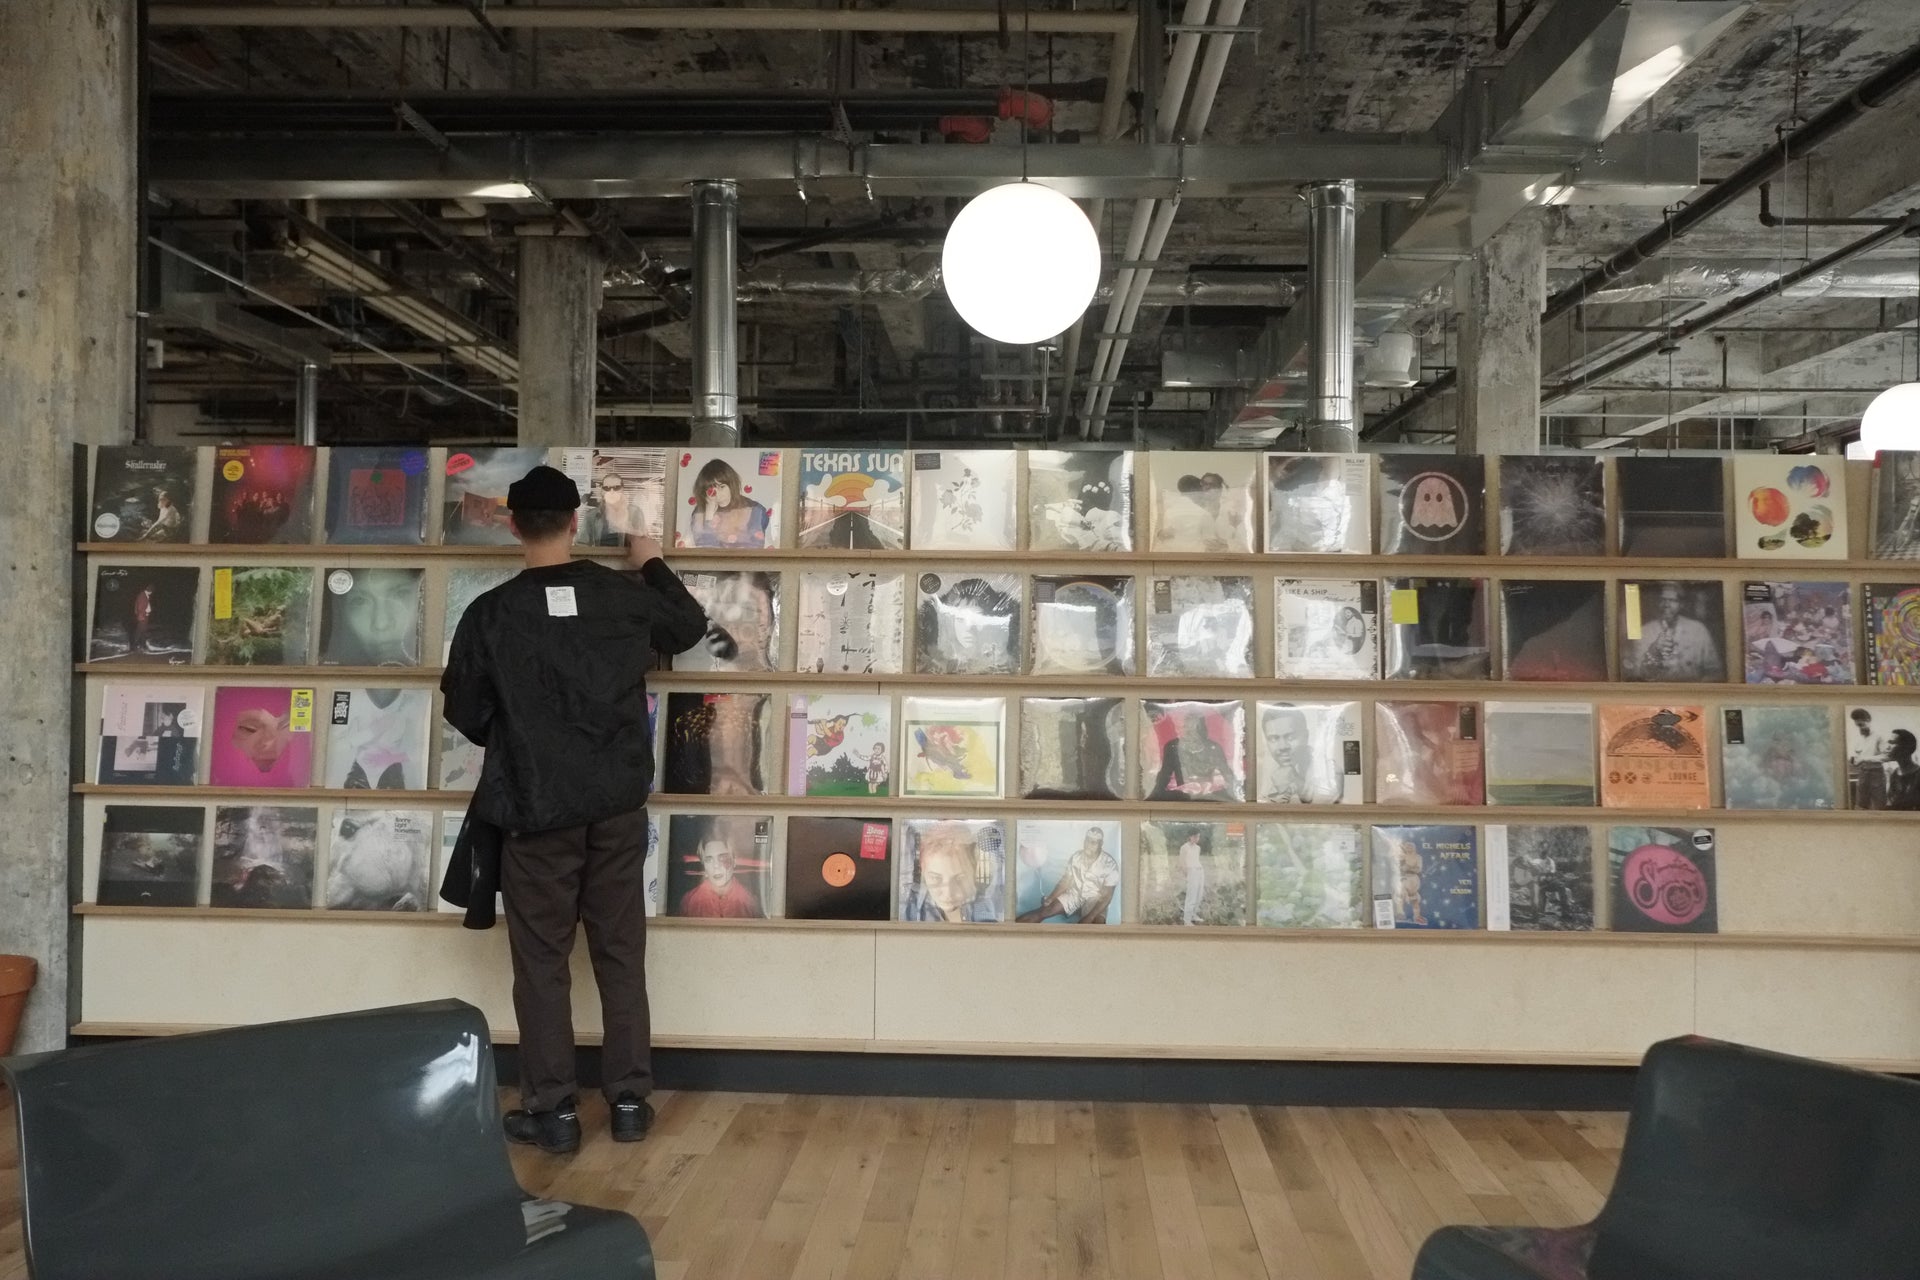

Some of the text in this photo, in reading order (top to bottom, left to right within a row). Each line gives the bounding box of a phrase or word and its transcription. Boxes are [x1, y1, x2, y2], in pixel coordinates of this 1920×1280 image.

[803, 453, 861, 472] TEXAS
[866, 453, 904, 472] SUN
[1868, 633, 1876, 685] STEVENS
[1668, 772, 1697, 781] LOUNGE
[1422, 842, 1471, 850] EL MICHELS
[1440, 852, 1471, 860] AFFAIR
